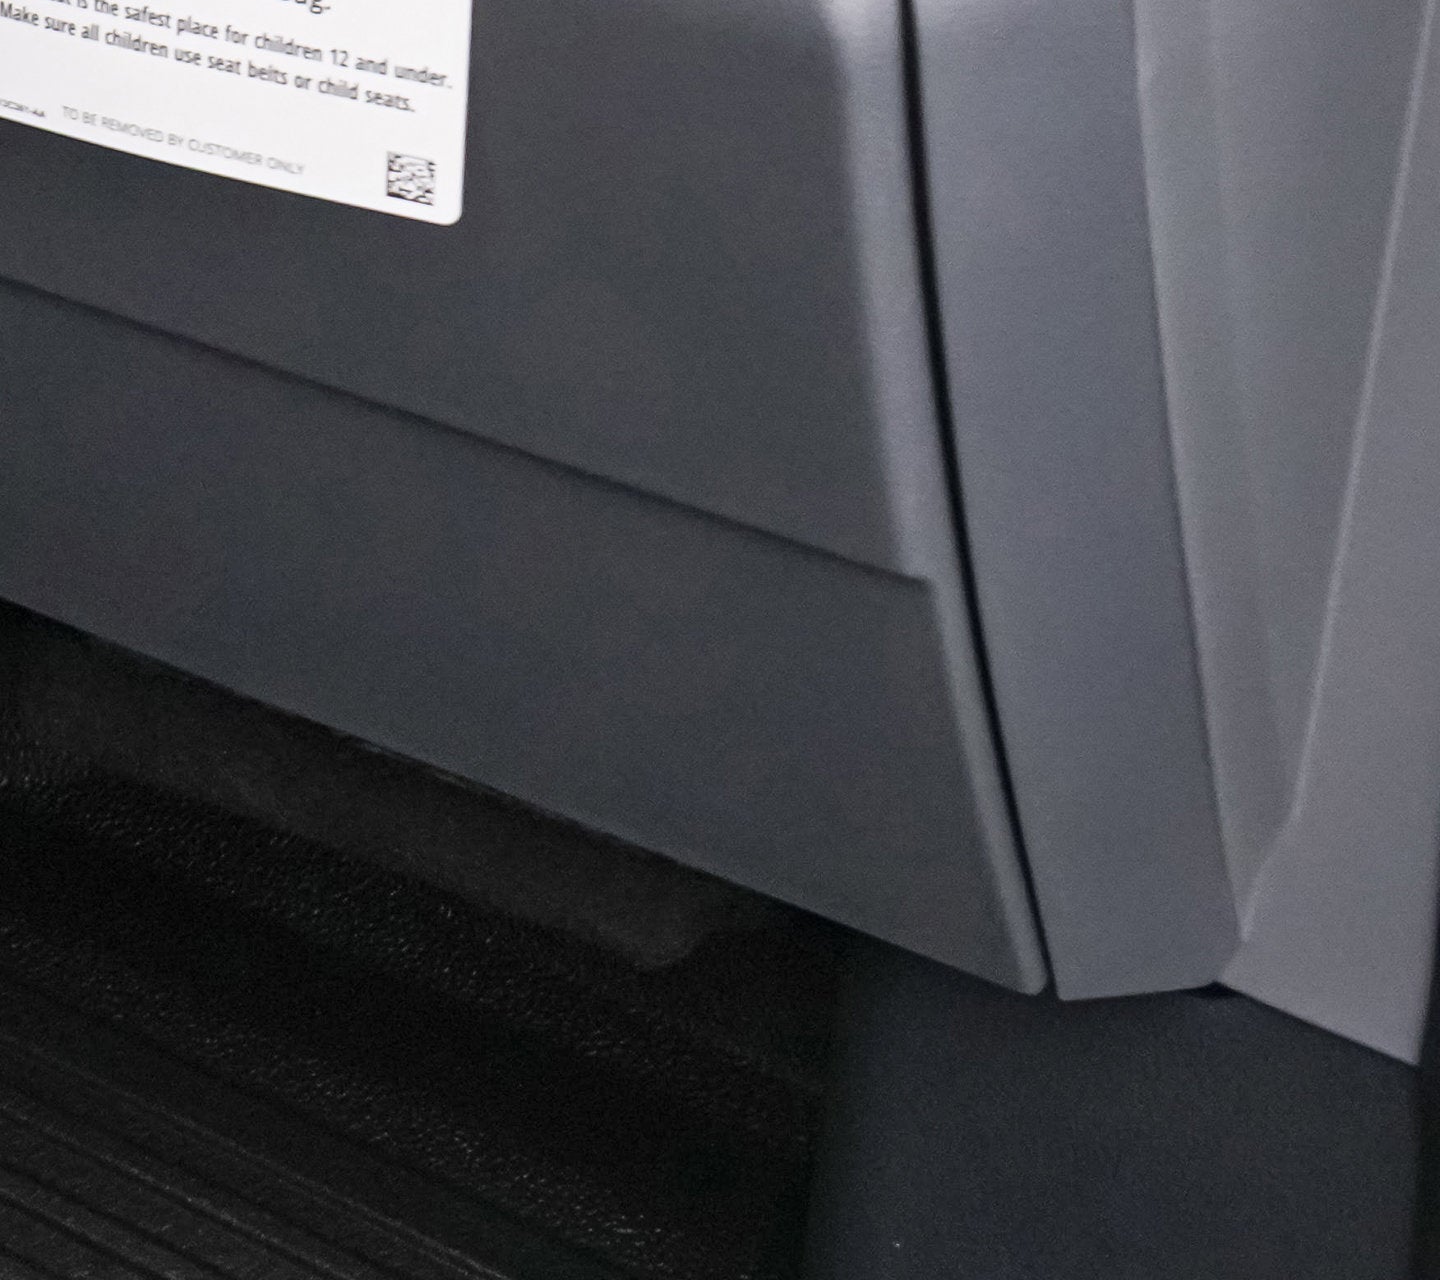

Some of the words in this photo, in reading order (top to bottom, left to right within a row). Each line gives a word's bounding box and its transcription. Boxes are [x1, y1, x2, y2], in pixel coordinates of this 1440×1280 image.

[0, 0, 40, 27] Make
[44, 15, 77, 37] sure
[81, 23, 99, 42] all
[104, 29, 169, 58] children
[174, 46, 202, 67] use
[207, 54, 242, 76] seat
[247, 60, 288, 85] belts
[294, 75, 312, 91] or
[318, 78, 359, 100] child
[365, 89, 416, 113] seats.
[124, 5, 172, 29] safest
[177, 16, 219, 39] place
[225, 24, 249, 46] for
[254, 32, 323, 62] children
[330, 48, 349, 68] 12
[355, 56, 388, 76] and
[394, 65, 453, 89] under.
[62, 105, 80, 121] TO
[82, 111, 98, 127] BE
[101, 116, 164, 143] REMOVED
[168, 132, 184, 147] BY
[188, 138, 263, 165] CUSTOMER
[267, 156, 305, 175] ONLY
